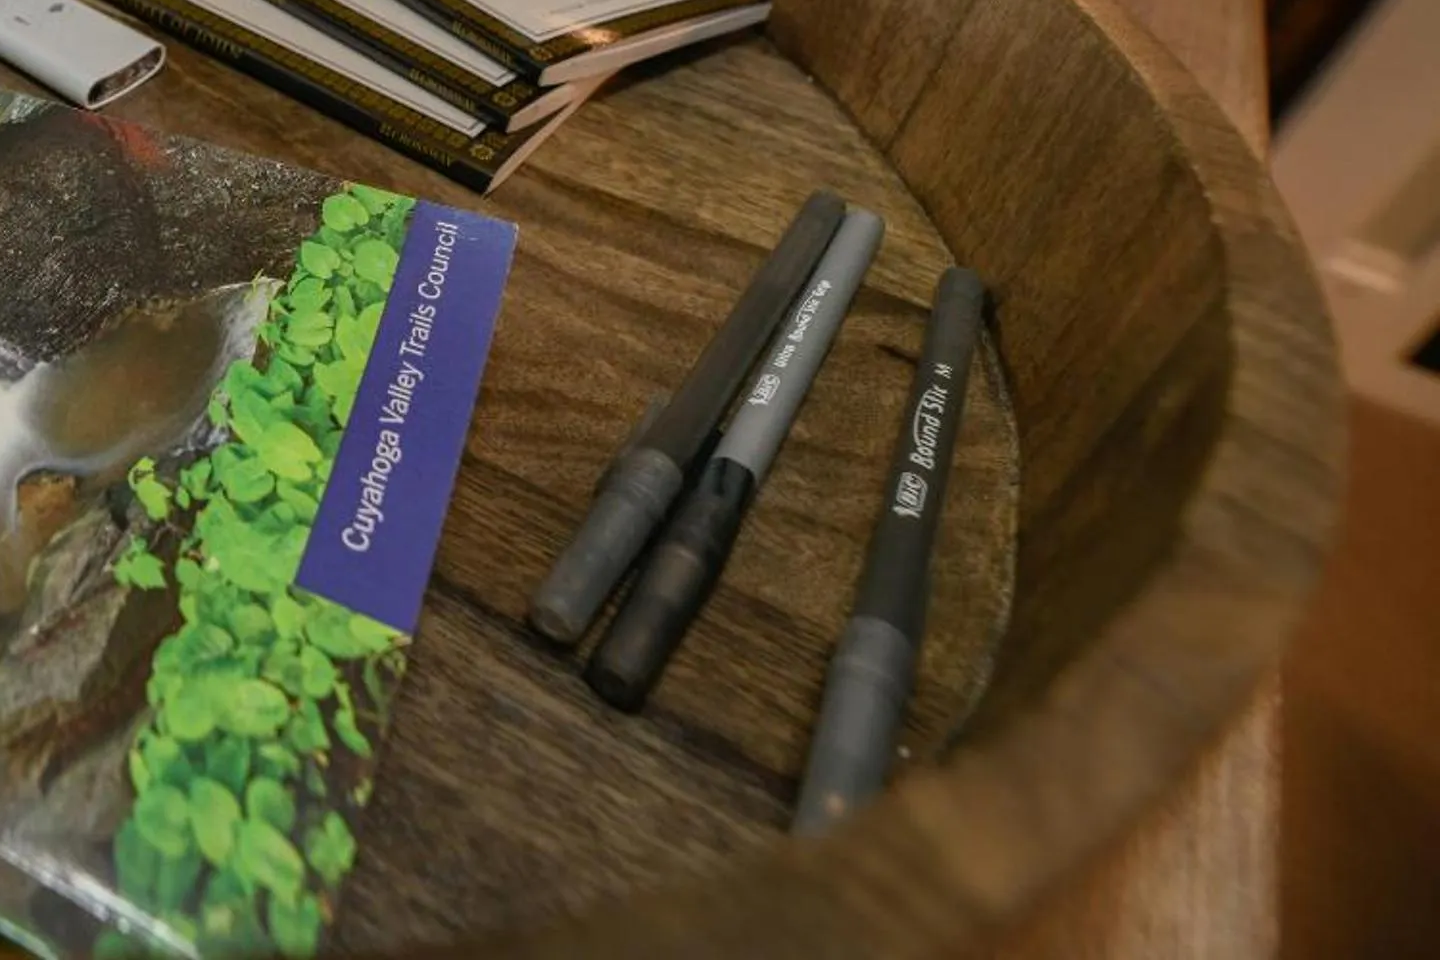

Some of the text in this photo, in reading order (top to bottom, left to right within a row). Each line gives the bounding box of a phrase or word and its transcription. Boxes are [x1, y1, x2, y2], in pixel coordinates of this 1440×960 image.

[341, 222, 460, 552] Cuyahoga Valley Trails Council
[921, 385, 949, 415] Stic
[909, 412, 942, 470] Round
